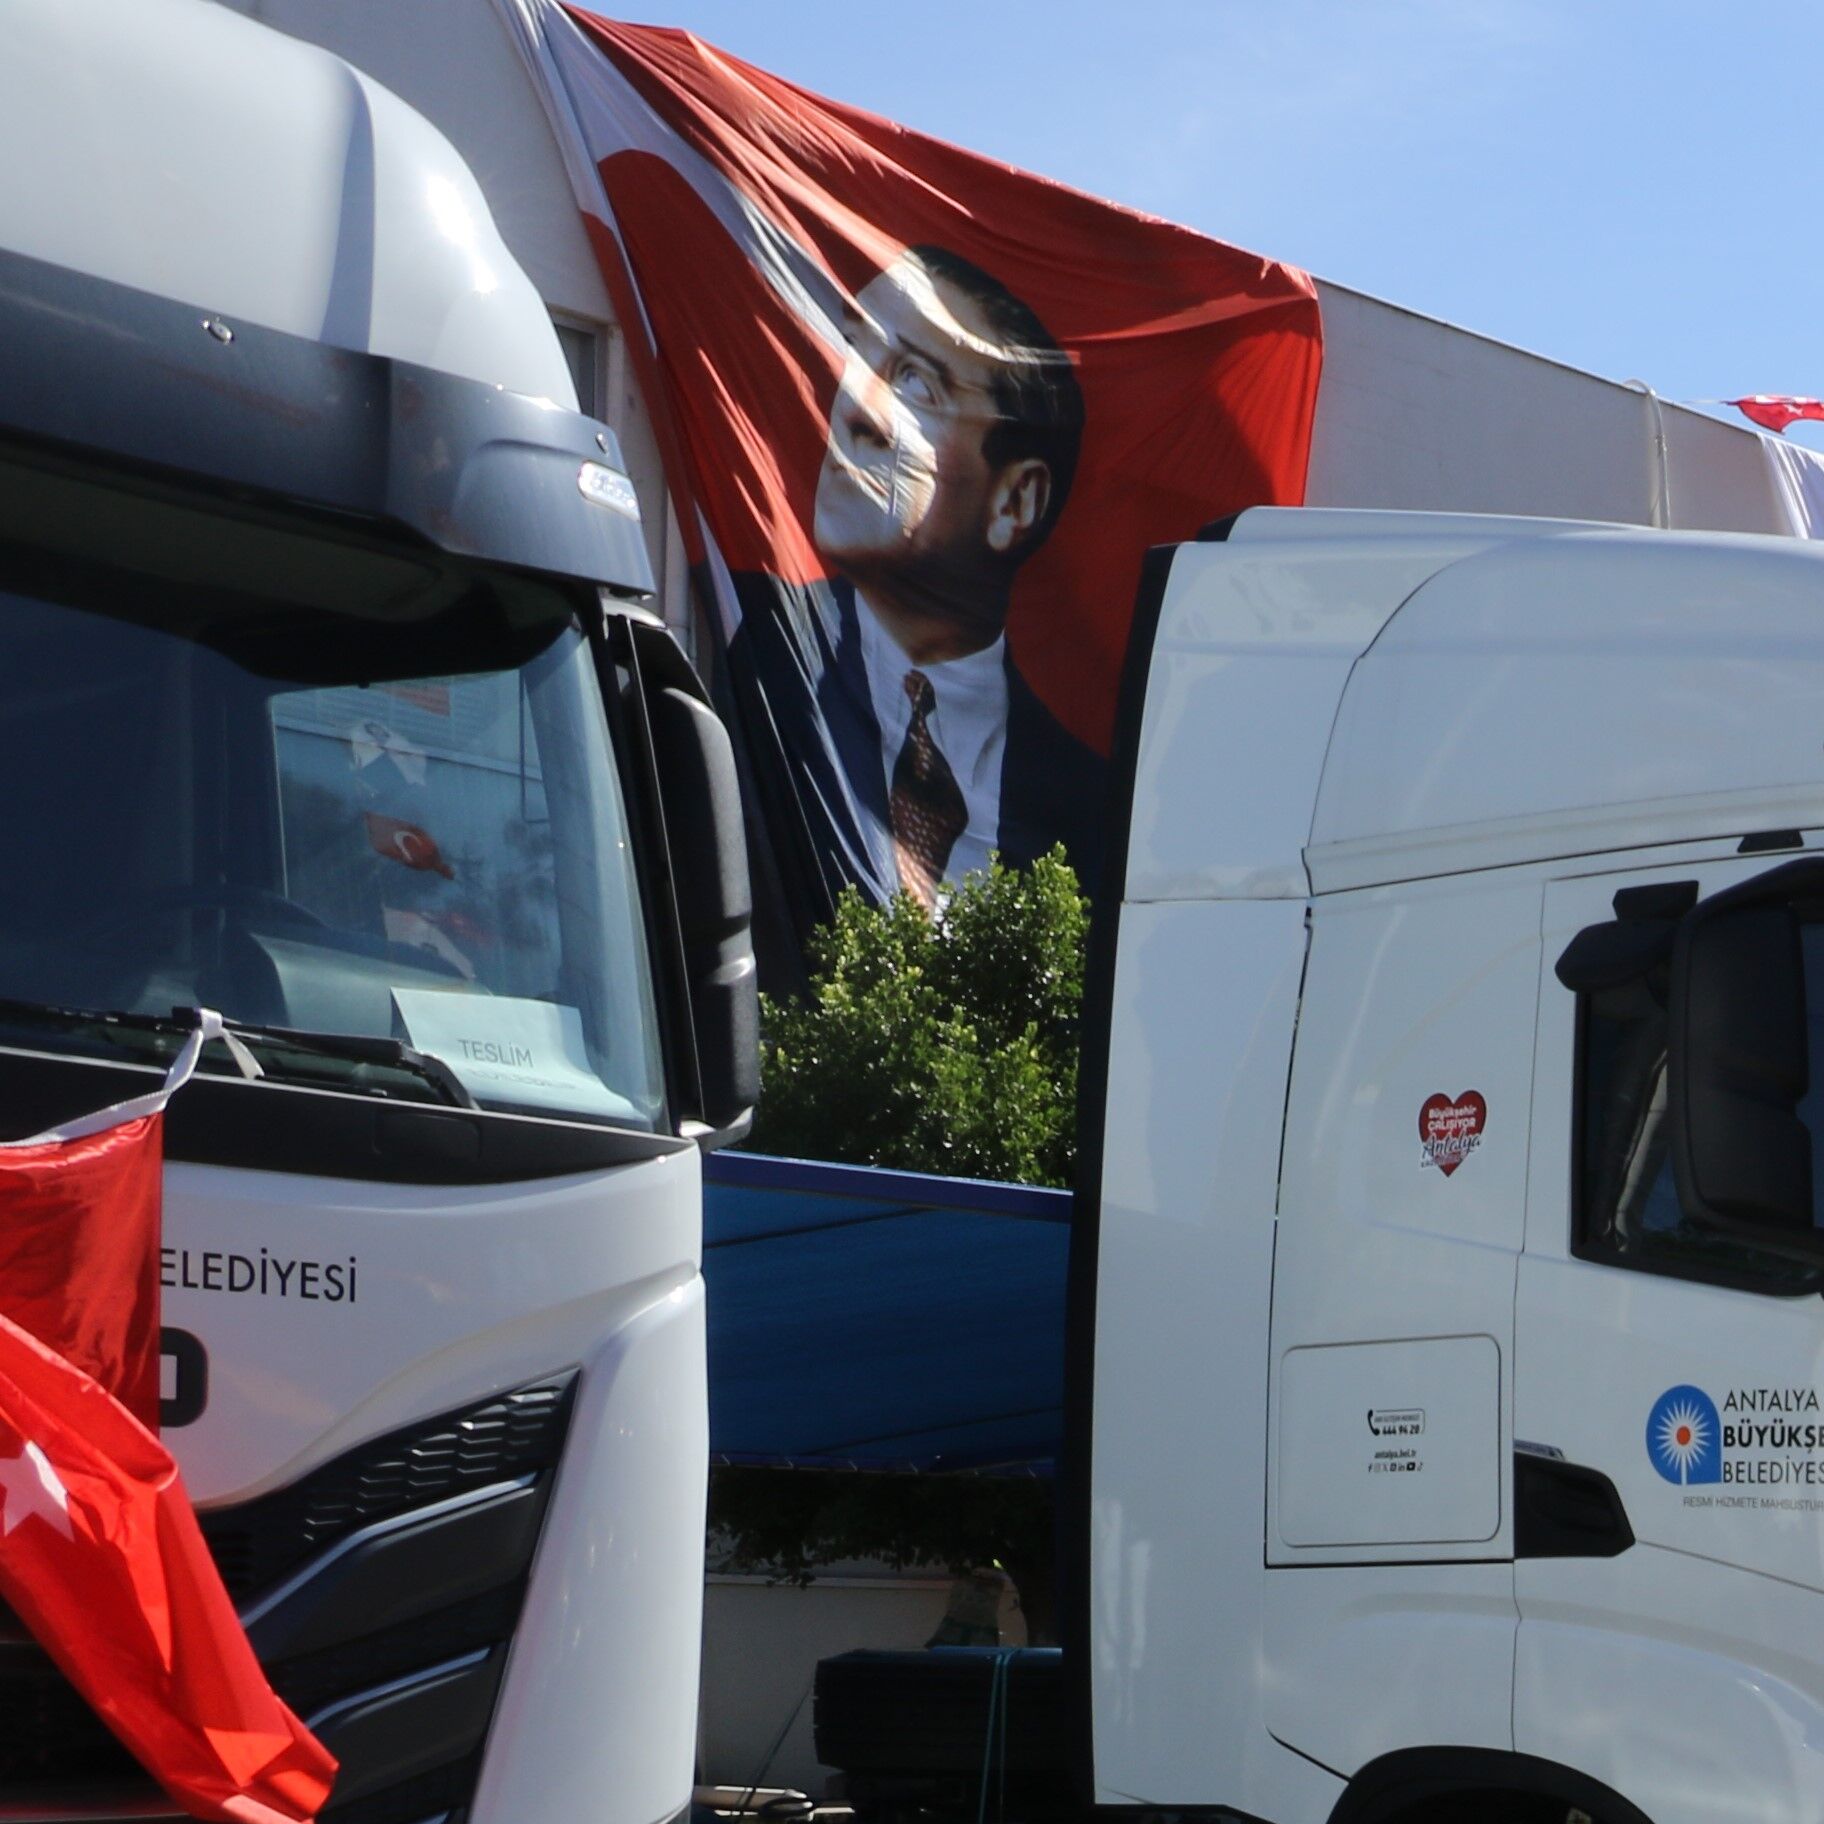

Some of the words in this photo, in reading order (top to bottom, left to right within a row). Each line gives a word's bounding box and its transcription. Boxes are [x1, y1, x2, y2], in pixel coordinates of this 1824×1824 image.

[457, 1038, 534, 1068] TESLİM
[1422, 1132, 1480, 1159] Antalya
[159, 1247, 356, 1303] ELEDİYESİ
[1723, 1389, 1820, 1413] ANTALYA
